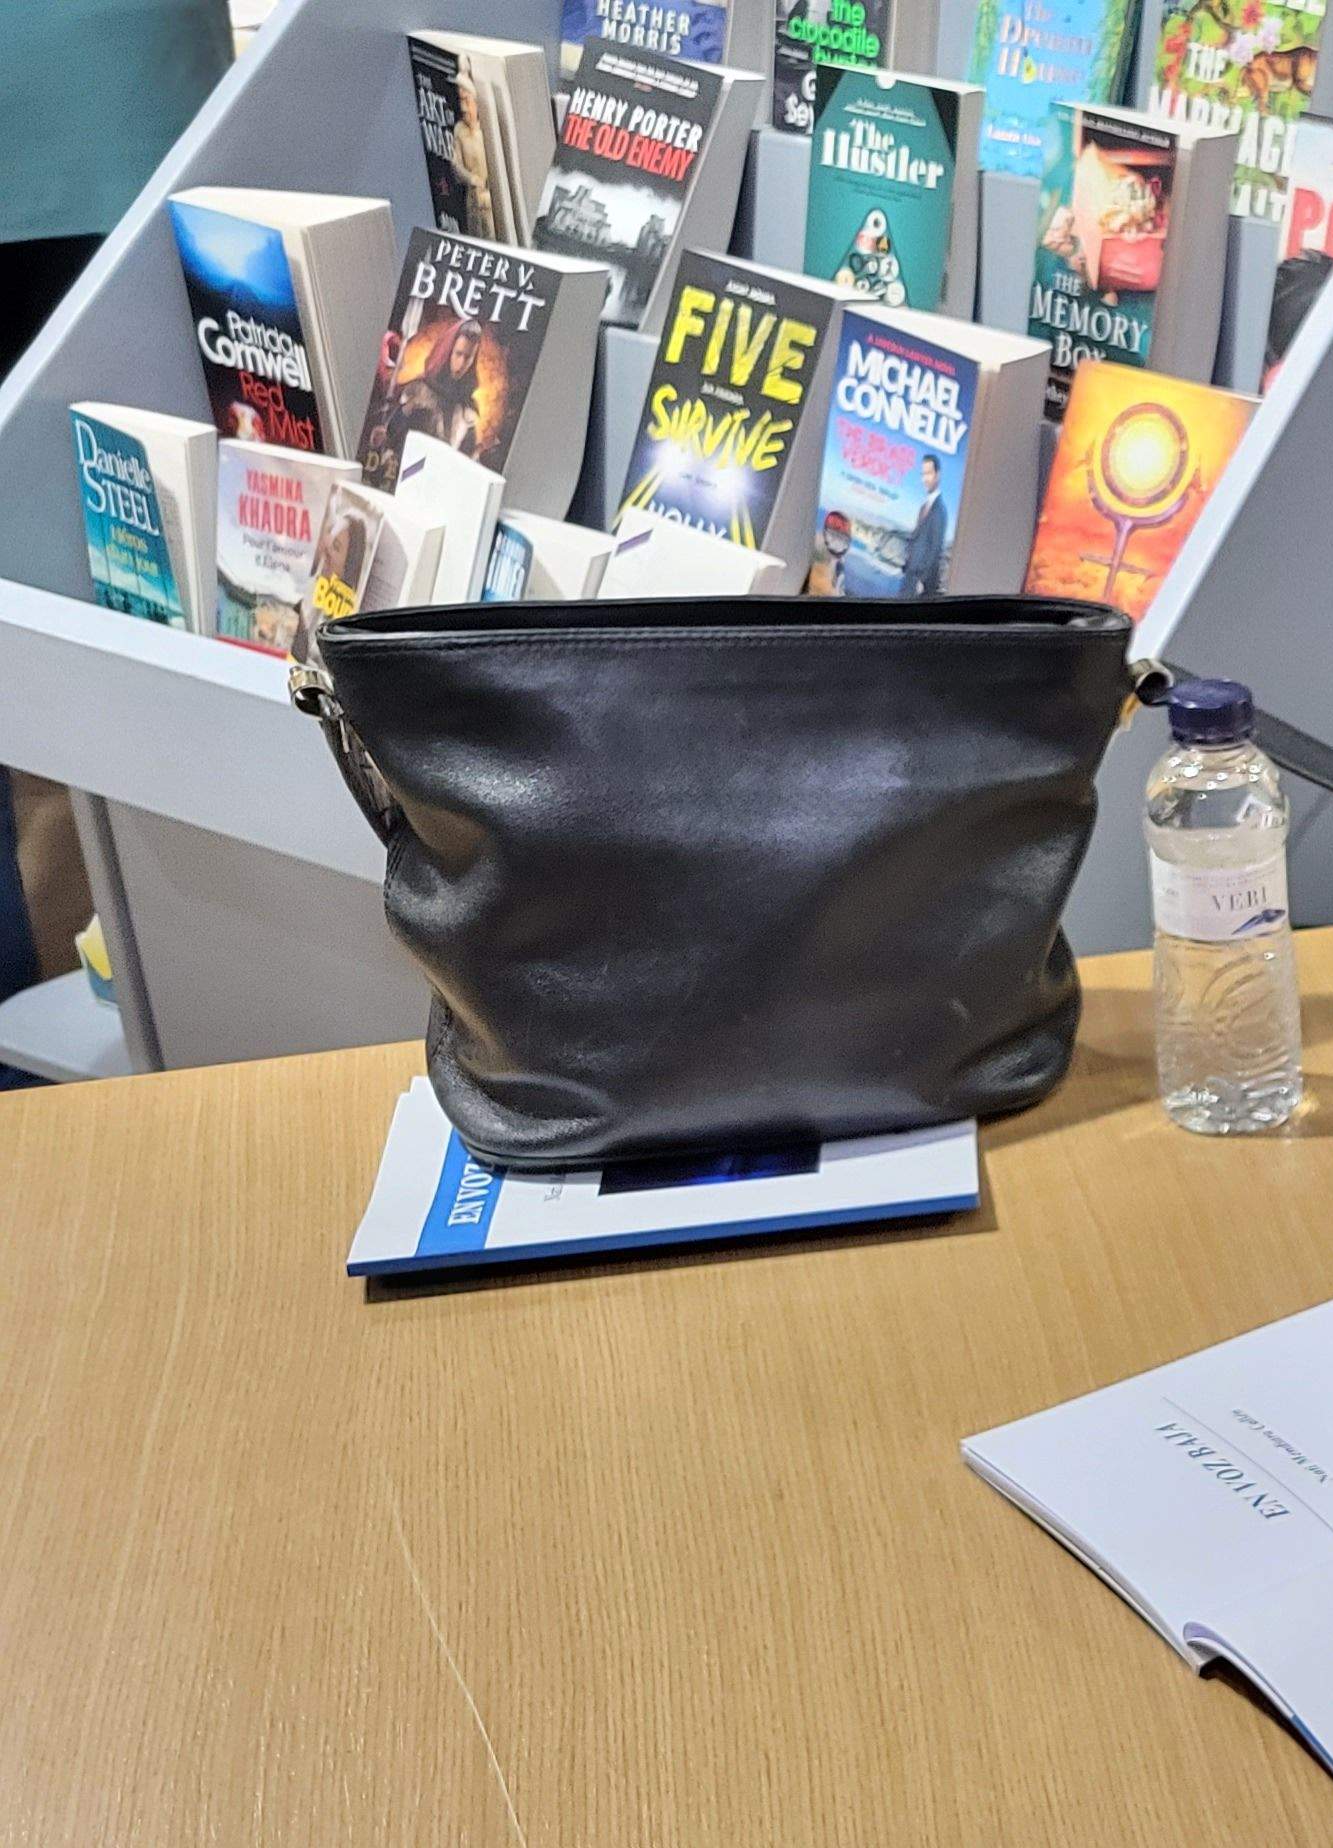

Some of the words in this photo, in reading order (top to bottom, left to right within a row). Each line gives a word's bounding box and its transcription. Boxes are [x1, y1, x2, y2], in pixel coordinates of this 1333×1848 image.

[602, 19, 682, 54] MORRIS
[788, 16, 880, 58] crocodile
[1187, 42, 1229, 82] THE
[570, 87, 630, 126] HENRY
[628, 104, 703, 152] PORTER
[849, 118, 895, 153] The
[564, 113, 594, 148] THE
[594, 122, 630, 161] OLD
[627, 136, 697, 181] ENEMY
[820, 127, 944, 190] Hustler
[434, 239, 511, 283] PETER
[516, 264, 536, 291] V.
[1054, 271, 1082, 297] THE
[410, 261, 546, 333] BRETT
[1030, 282, 1147, 354] MEMORY
[197, 317, 313, 392] Cornwell
[226, 310, 293, 356] Patricia
[665, 285, 818, 405] FIVE
[239, 371, 285, 412] Red
[847, 339, 963, 421] MICHAEL
[269, 406, 316, 450] Mist
[647, 384, 794, 471] SURVIVE
[836, 376, 968, 456] CONNELLY
[75, 418, 152, 489] Danielle
[83, 460, 161, 536] STEEL
[246, 468, 304, 502] YASMINA
[238, 495, 313, 543] KHADRA
[1212, 886, 1267, 911] VERI
[447, 1199, 486, 1227] EN
[1154, 1422, 1217, 1459] BAJA
[1201, 1458, 1257, 1492] VOZ
[1244, 1492, 1290, 1519] EN
